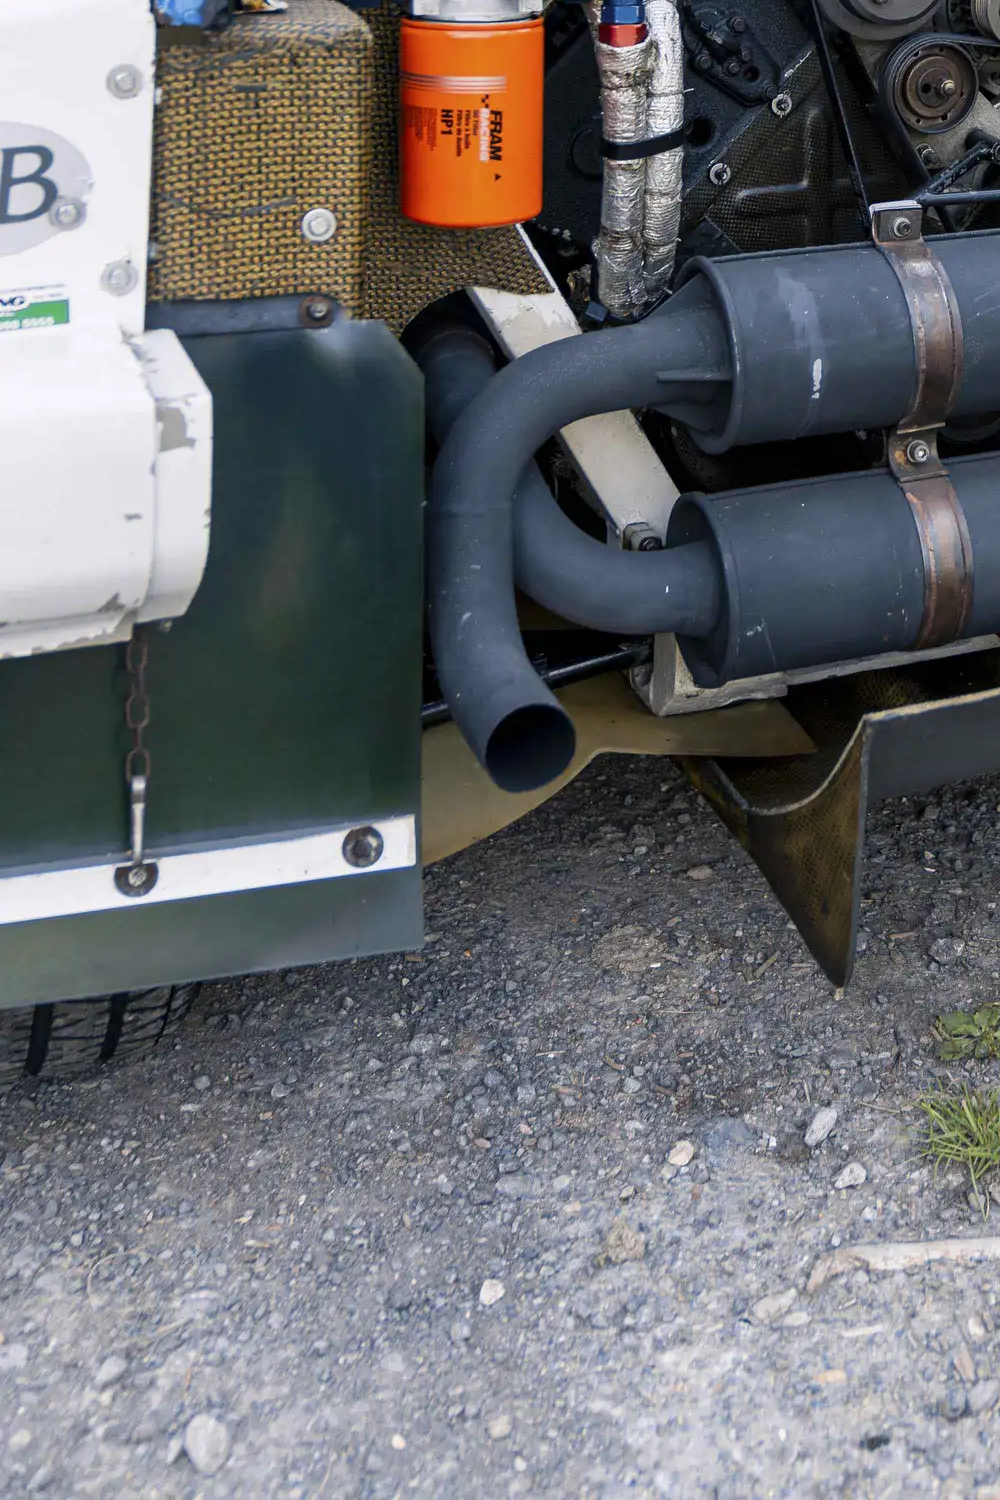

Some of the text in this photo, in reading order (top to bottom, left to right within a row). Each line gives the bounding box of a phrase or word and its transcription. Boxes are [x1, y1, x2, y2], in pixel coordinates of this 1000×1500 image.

[441, 109, 453, 135] HP1
[479, 108, 490, 163] RACING
[489, 110, 503, 162] FRAM
